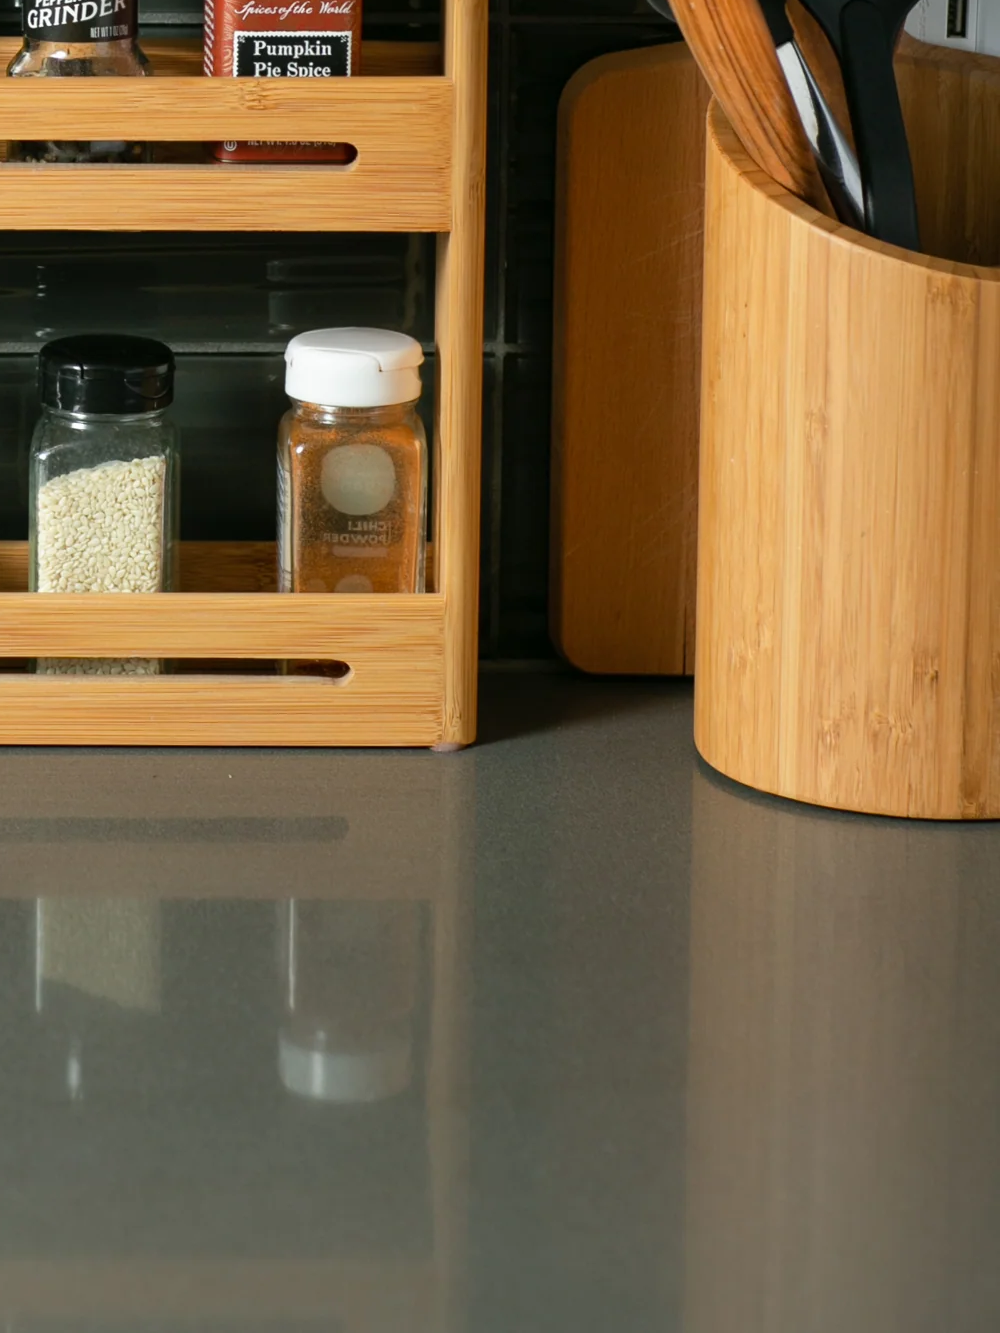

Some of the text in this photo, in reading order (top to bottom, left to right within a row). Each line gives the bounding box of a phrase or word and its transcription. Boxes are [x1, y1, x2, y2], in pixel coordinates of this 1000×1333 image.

[234, 0, 356, 20] Spices of the World
[253, 40, 332, 59] Pumpkin
[253, 62, 331, 77] Pie Spice
